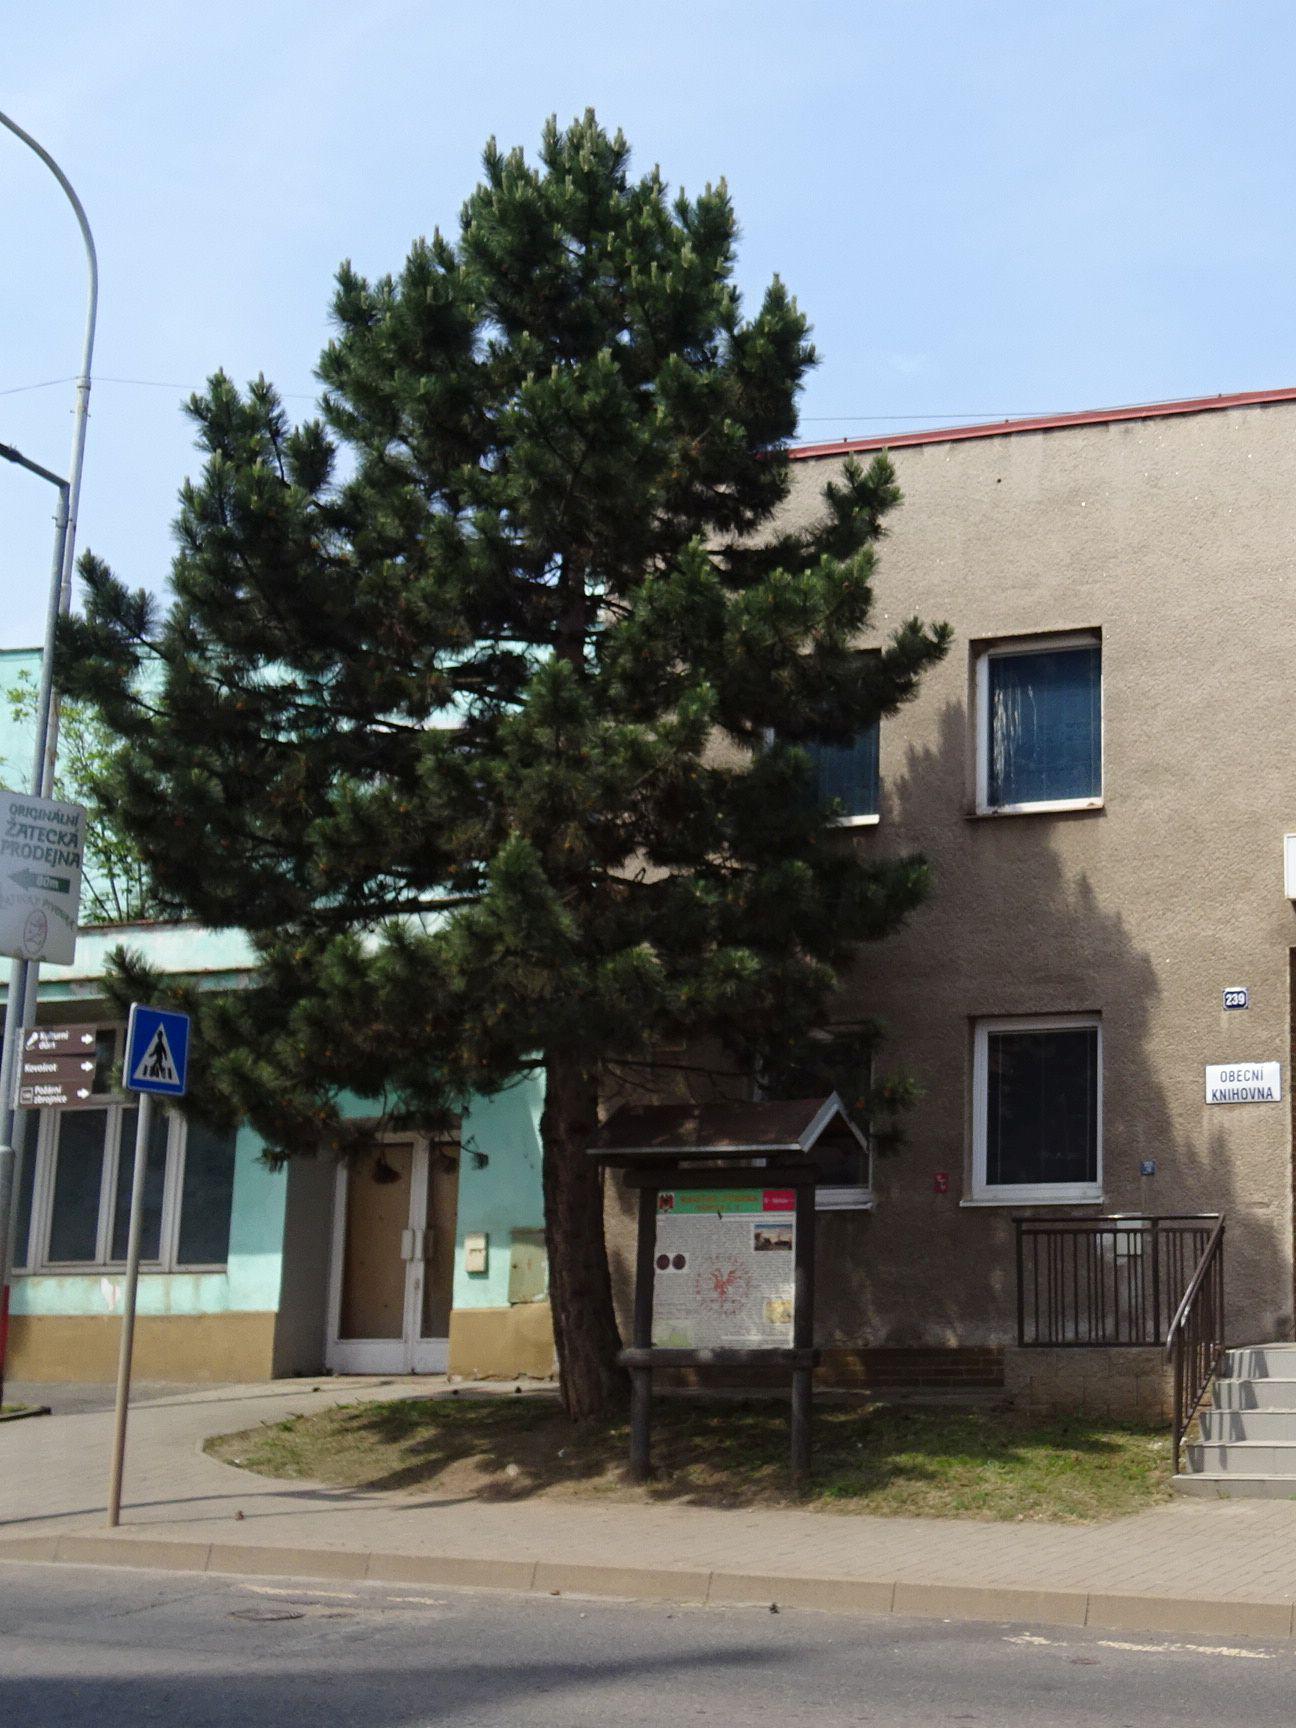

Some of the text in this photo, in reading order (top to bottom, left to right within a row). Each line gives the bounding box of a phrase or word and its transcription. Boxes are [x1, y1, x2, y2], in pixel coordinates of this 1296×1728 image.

[9, 803, 80, 826] ORIGINÁLNÍ
[1, 840, 80, 868] PRODEJNA
[1225, 992, 1246, 1006] 239
[1220, 1066, 1264, 1083] OBECNÍ
[1211, 1087, 1274, 1101] KNIHOVNA
